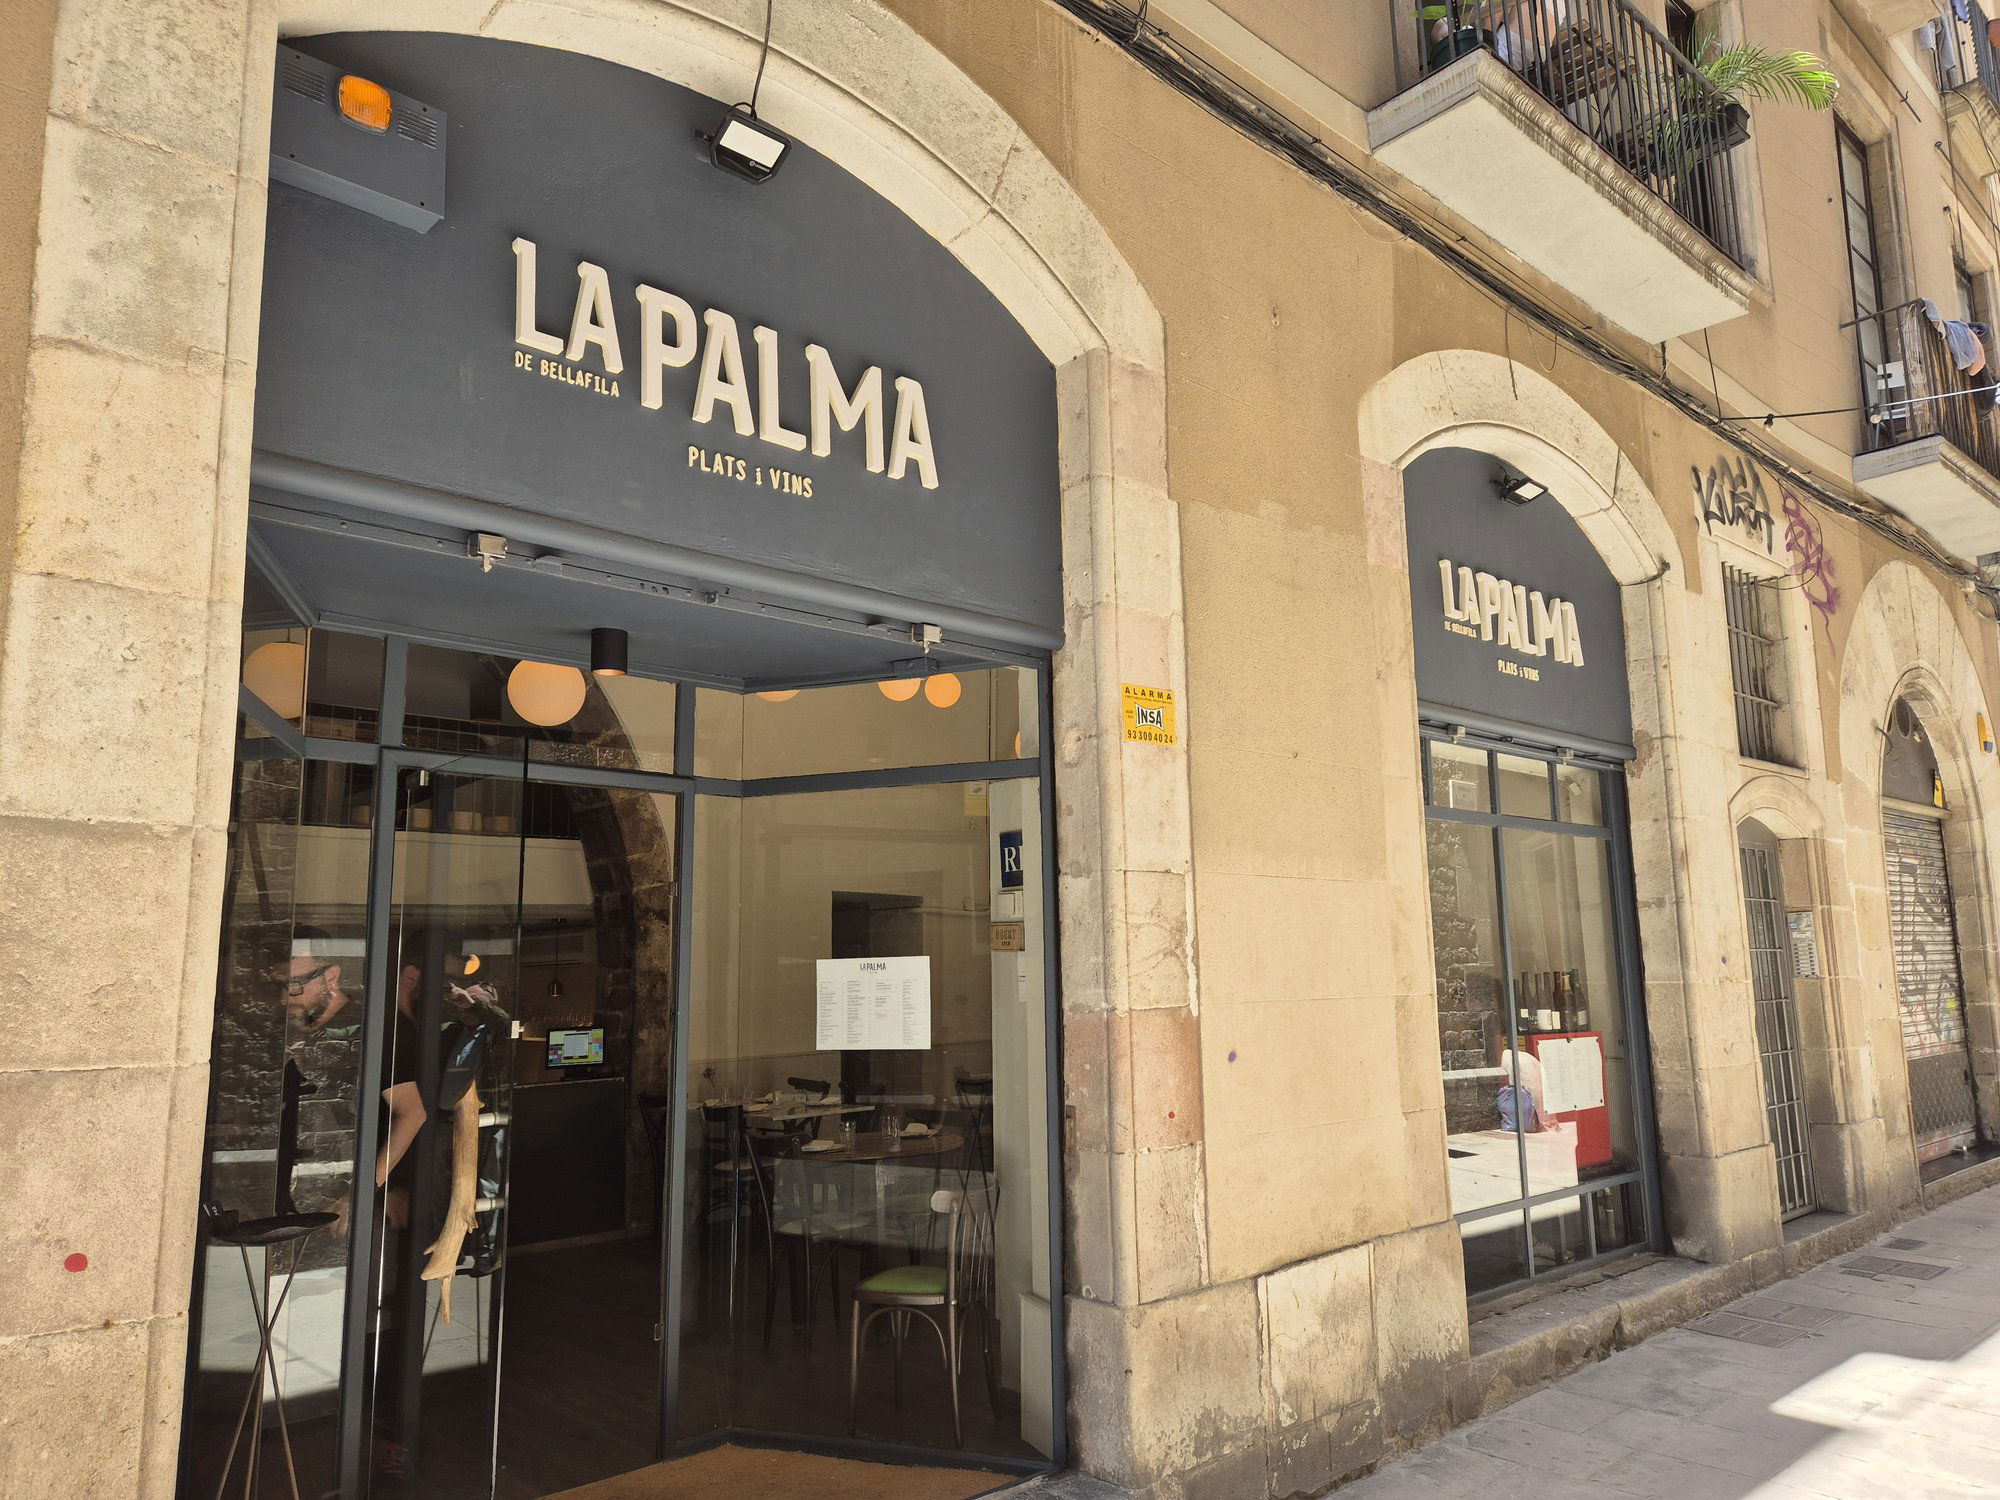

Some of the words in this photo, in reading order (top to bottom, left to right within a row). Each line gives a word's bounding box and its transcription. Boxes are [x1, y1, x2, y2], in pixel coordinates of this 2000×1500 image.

[512, 237, 624, 374] LA
[635, 283, 939, 490] PALMA
[514, 350, 533, 371] DE
[540, 359, 620, 398] BELLAFILA
[688, 445, 747, 481] PLATS
[769, 467, 813, 498] VINS
[1439, 559, 1481, 625] LA
[1476, 571, 1584, 667] PALMA
[1125, 687, 1172, 700] ALARMA
[1137, 706, 1163, 728] INSA
[866, 962, 887, 971] PALMA
